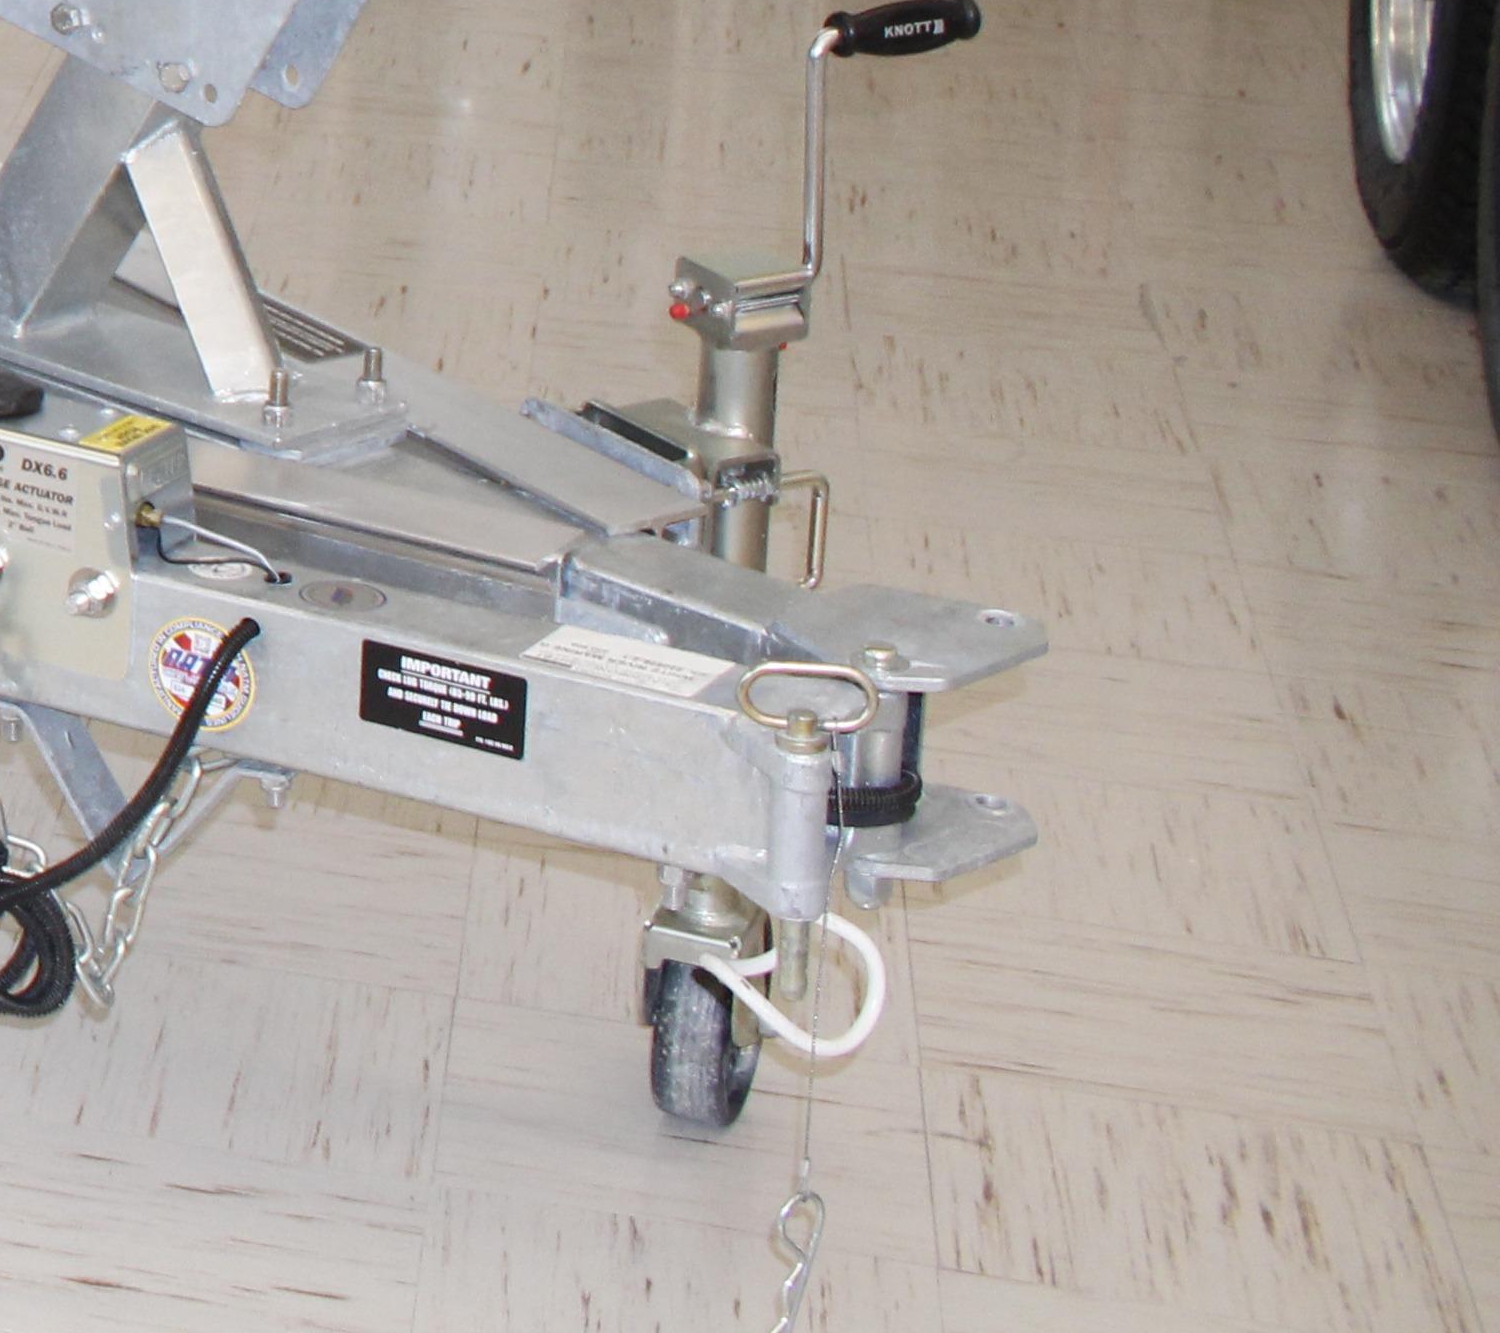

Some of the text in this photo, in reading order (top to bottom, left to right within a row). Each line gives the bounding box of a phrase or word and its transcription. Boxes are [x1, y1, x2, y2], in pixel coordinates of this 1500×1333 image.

[884, 20, 932, 39] KNOTT
[21, 457, 68, 481] DX6.6
[13, 482, 74, 506] ACTUATOR
[377, 668, 401, 683] CHECK
[419, 679, 447, 696] TORQUE
[400, 655, 492, 690] IMPORTANT
[387, 686, 403, 700] AND
[422, 710, 443, 725] EACH
